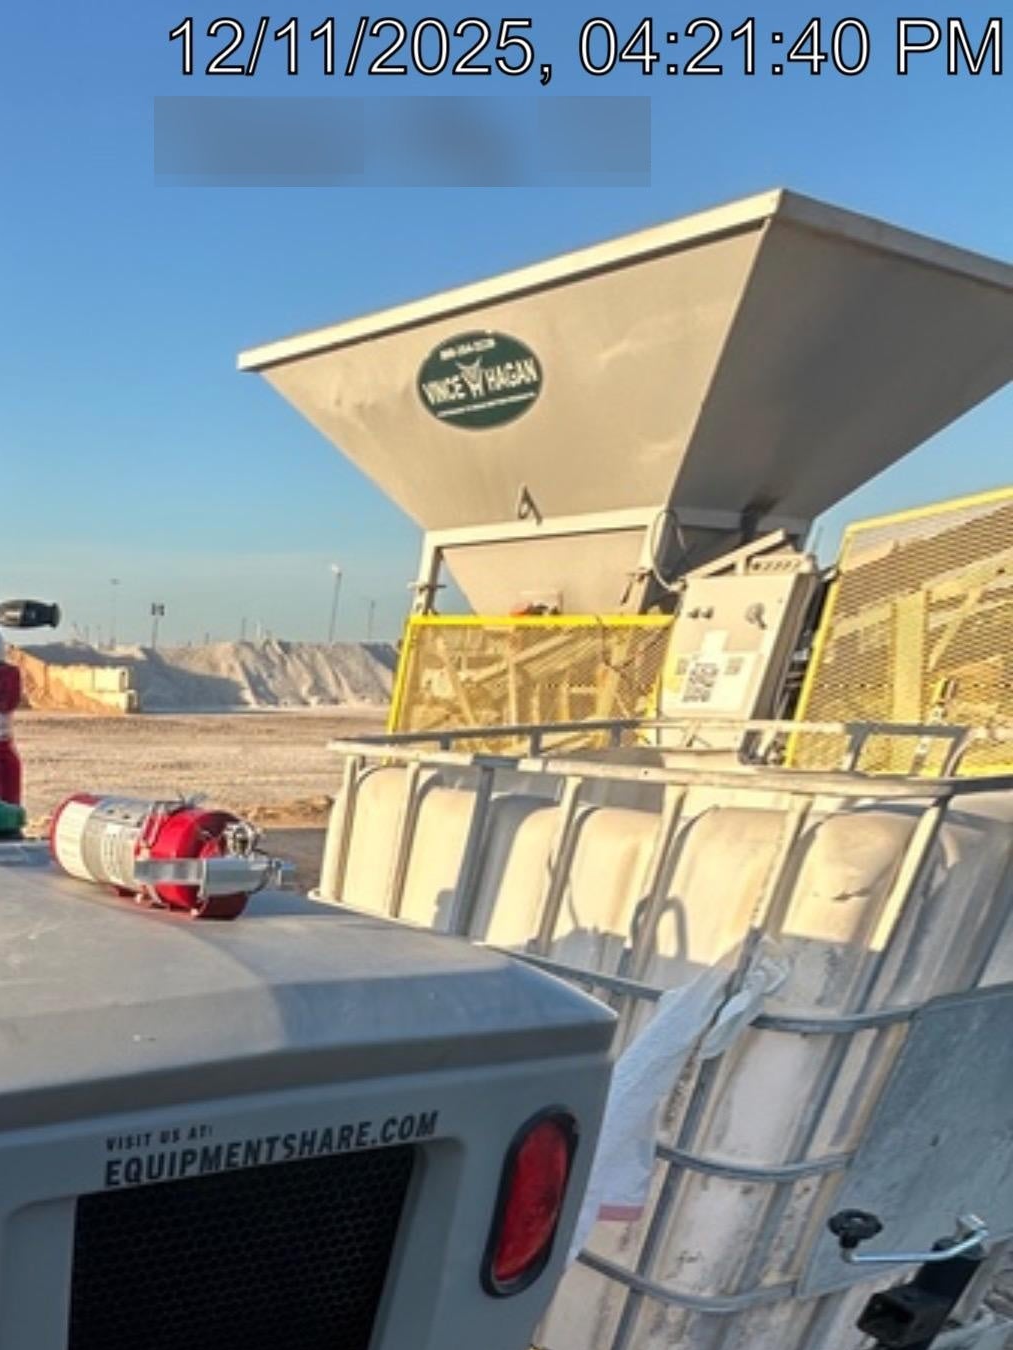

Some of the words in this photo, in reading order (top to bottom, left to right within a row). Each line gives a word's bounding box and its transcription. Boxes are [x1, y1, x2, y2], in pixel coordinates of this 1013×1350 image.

[485, 358, 538, 392] HAGAN
[104, 1110, 440, 1188] EQUIPMENTSHARE.COM
[106, 1132, 151, 1152] VISIT
[160, 1127, 180, 1144] US
